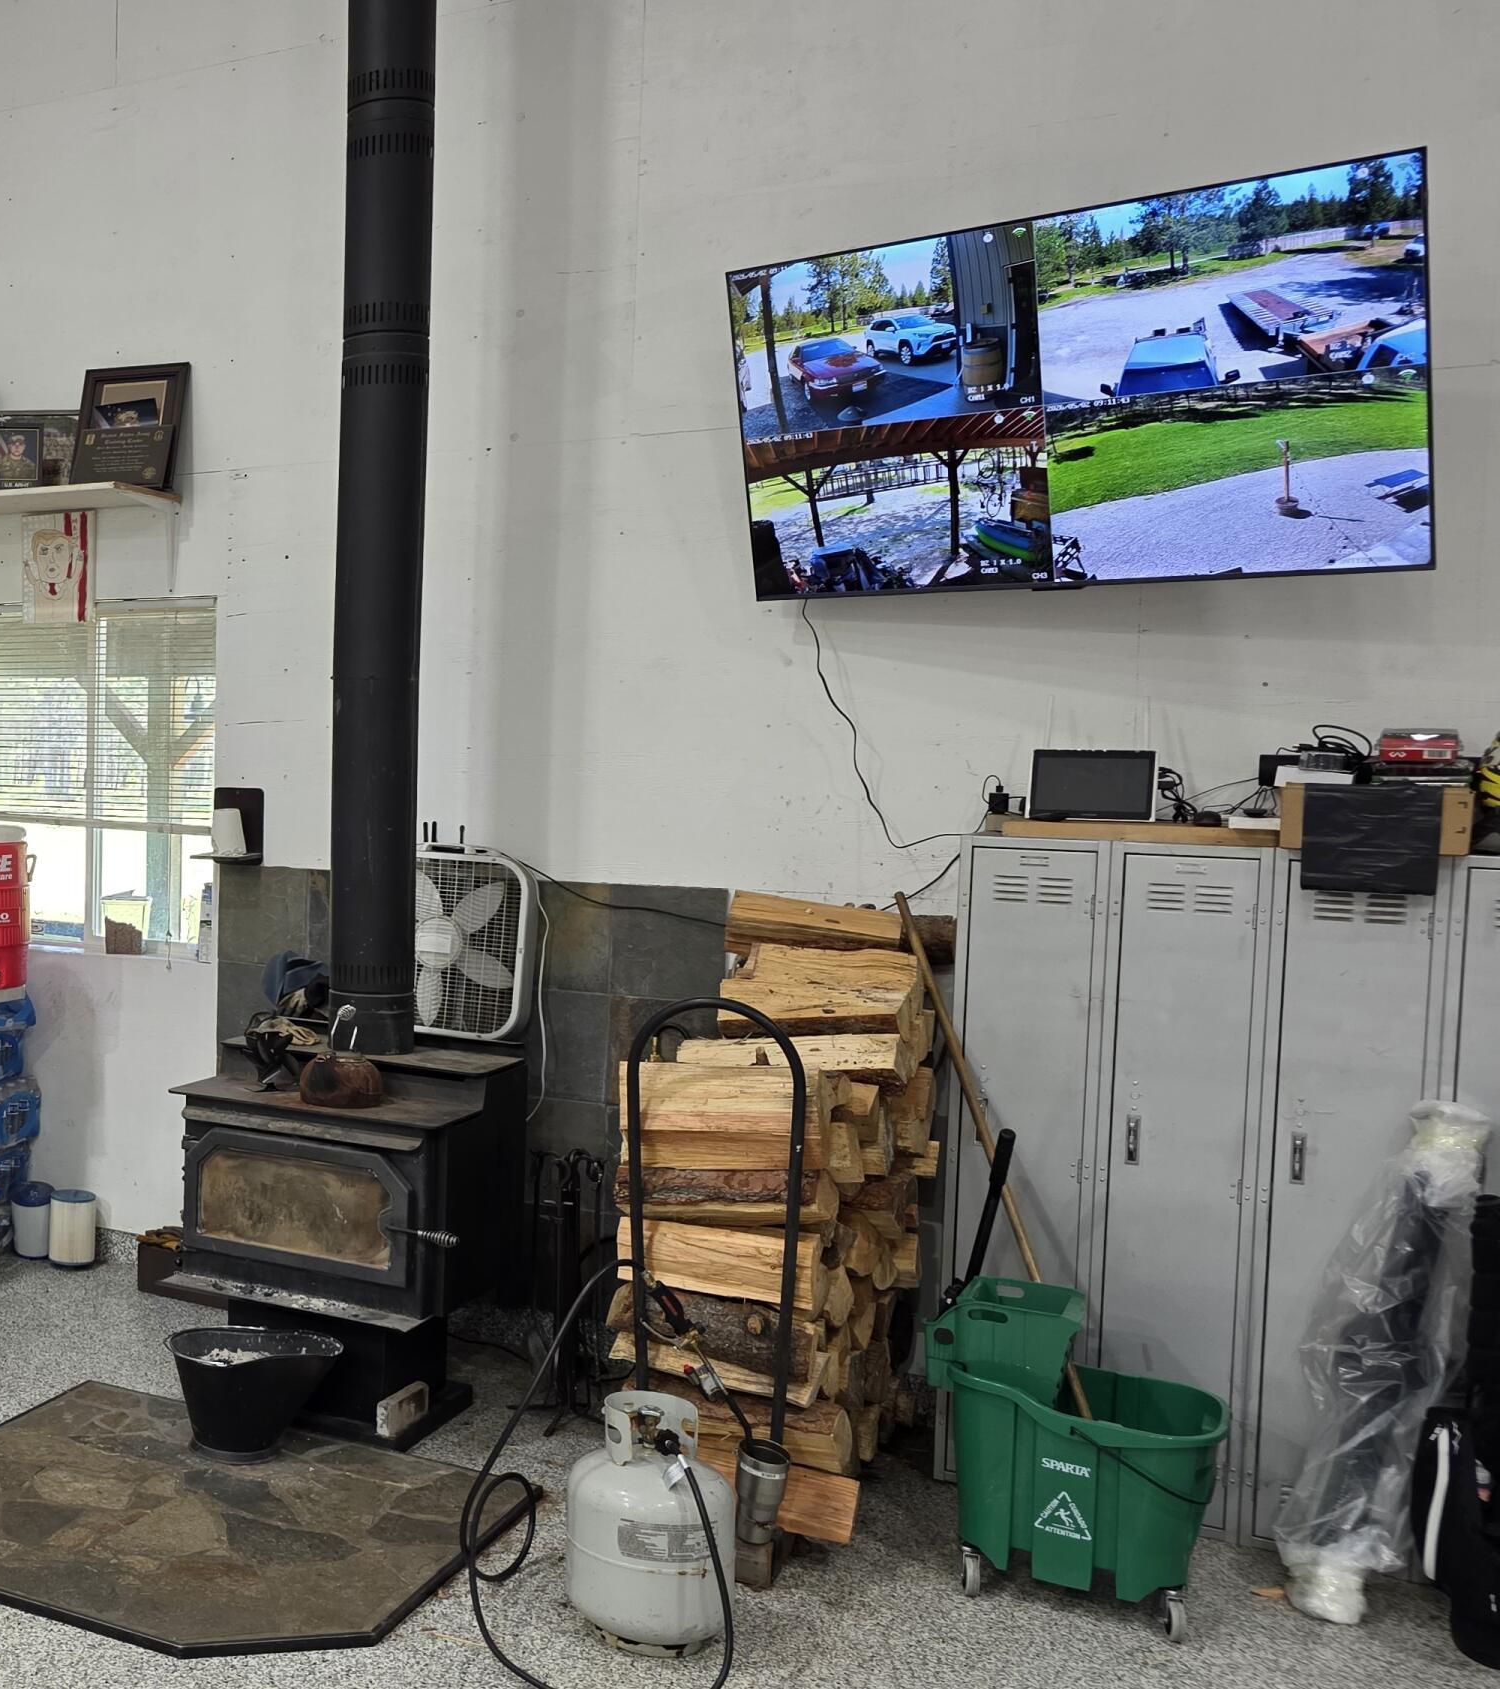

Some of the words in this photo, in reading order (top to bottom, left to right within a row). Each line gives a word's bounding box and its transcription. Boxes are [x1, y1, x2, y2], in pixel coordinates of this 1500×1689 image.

[1019, 395, 1035, 404] CH1
[1031, 571, 1048, 580] CH3
[1041, 1457, 1090, 1478] SPARTA
[1040, 1498, 1060, 1519] CAUTION
[1068, 1502, 1088, 1529] CUIDADO
[1044, 1525, 1081, 1540] ATTENTION
